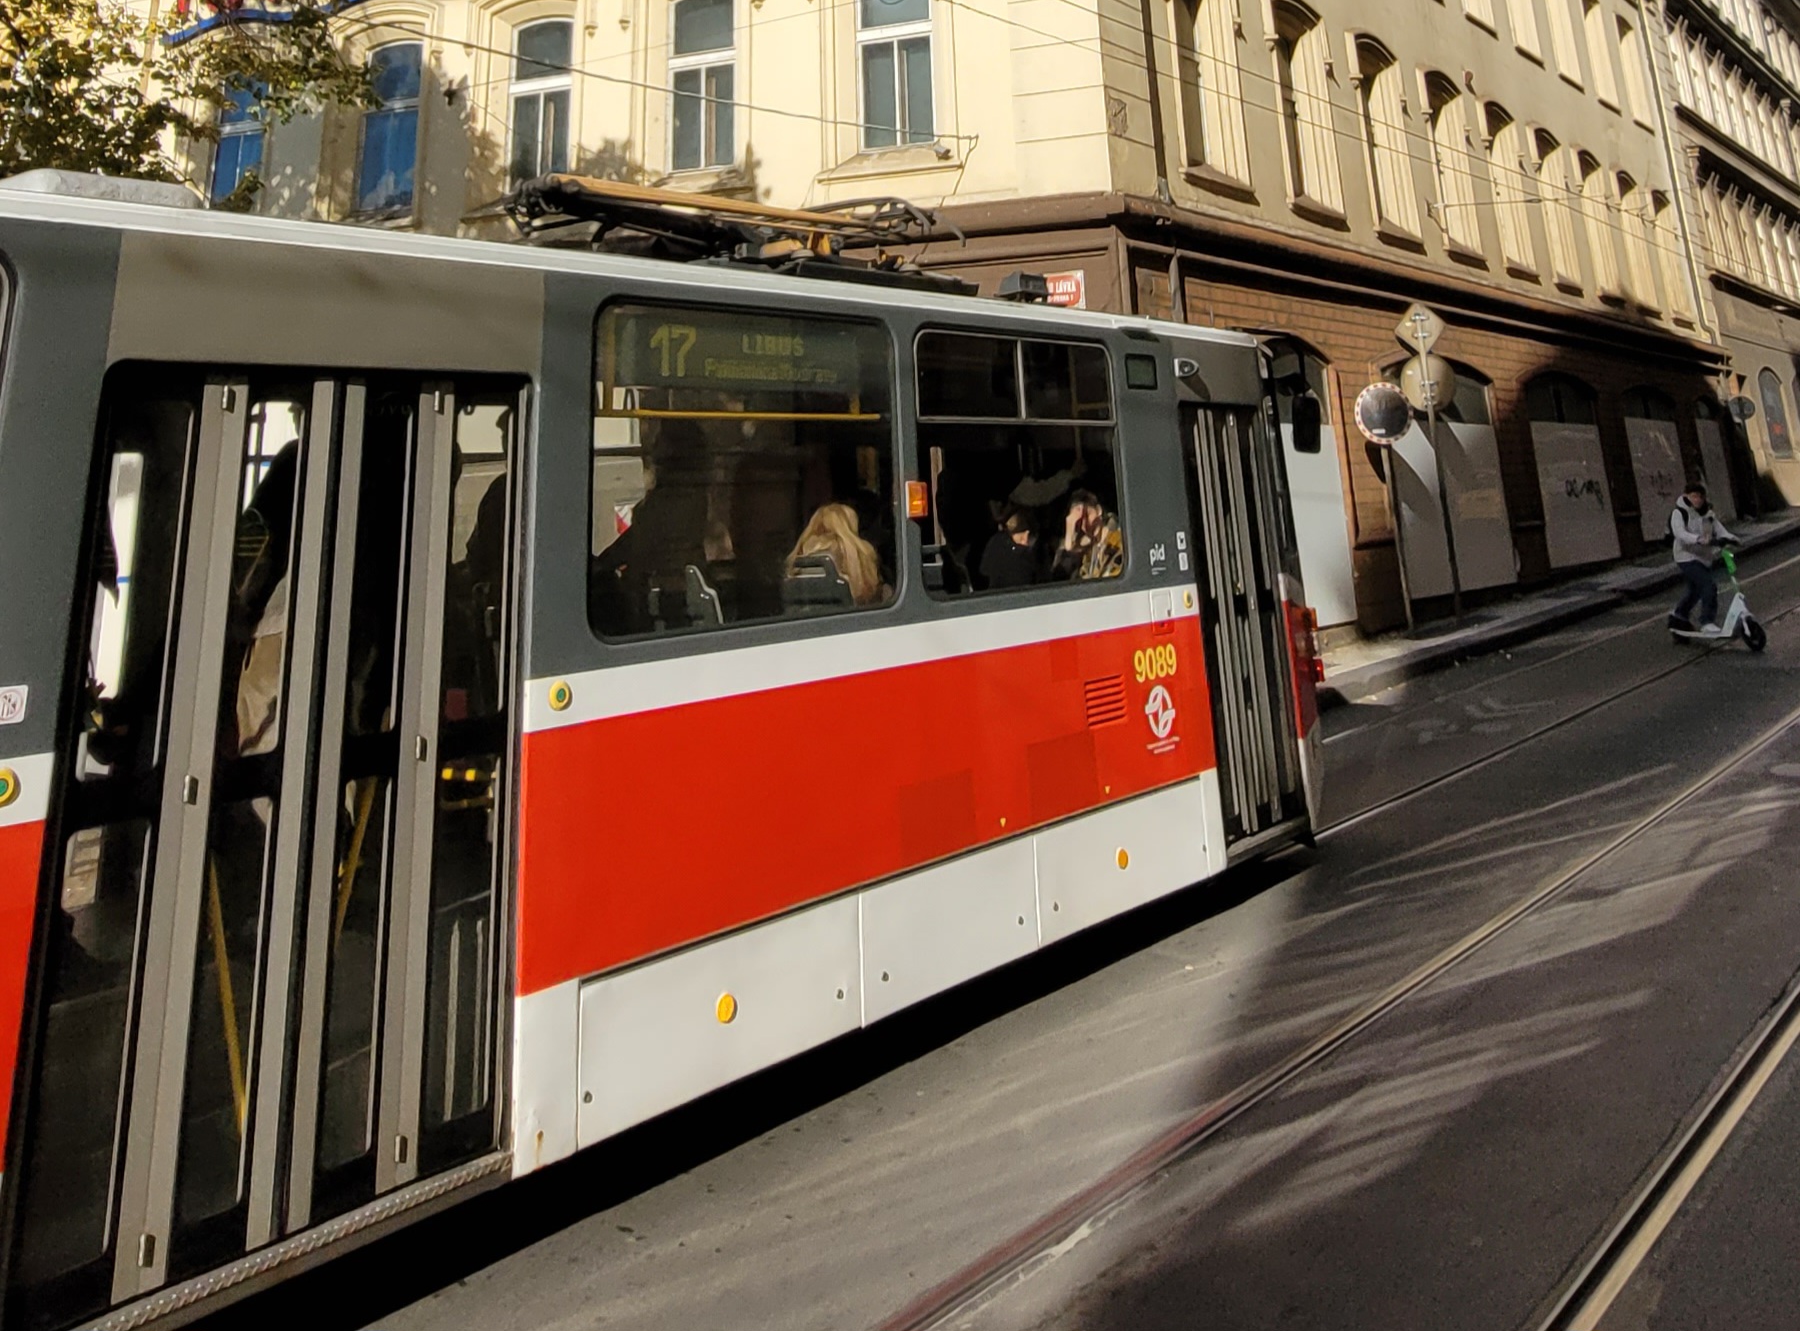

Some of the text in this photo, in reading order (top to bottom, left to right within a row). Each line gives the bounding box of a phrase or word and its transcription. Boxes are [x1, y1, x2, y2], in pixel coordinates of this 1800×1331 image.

[650, 325, 696, 377] 17
[1150, 543, 1165, 566] pid
[1134, 643, 1177, 683] 9089
